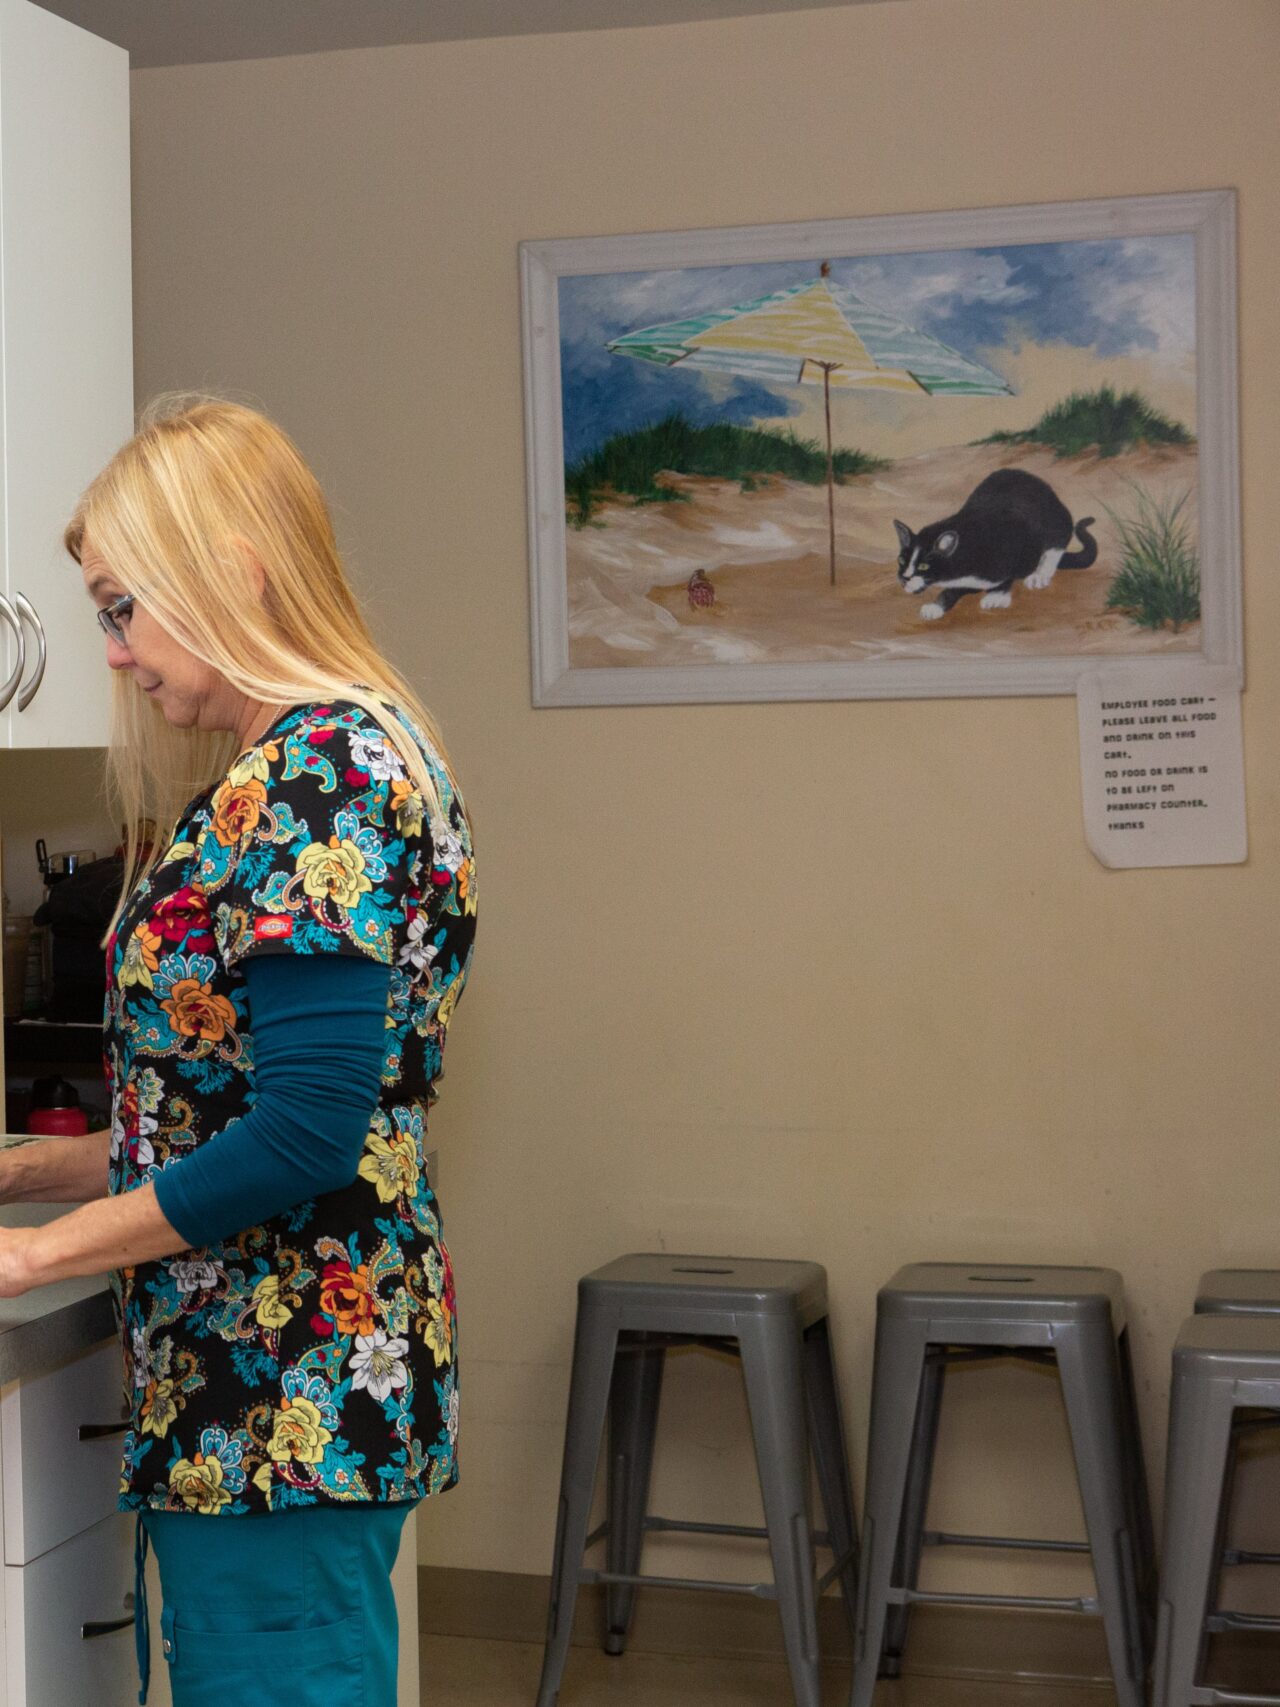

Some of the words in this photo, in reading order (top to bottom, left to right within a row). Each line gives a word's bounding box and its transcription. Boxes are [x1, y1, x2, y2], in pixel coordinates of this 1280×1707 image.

[1101, 700, 1149, 711] EMPLOYEE
[1152, 698, 1177, 708] FOOD
[1192, 712, 1217, 722] FOOD
[1121, 768, 1146, 778] FOOD
[1198, 765, 1208, 774] IS
[1121, 785, 1132, 795] BE
